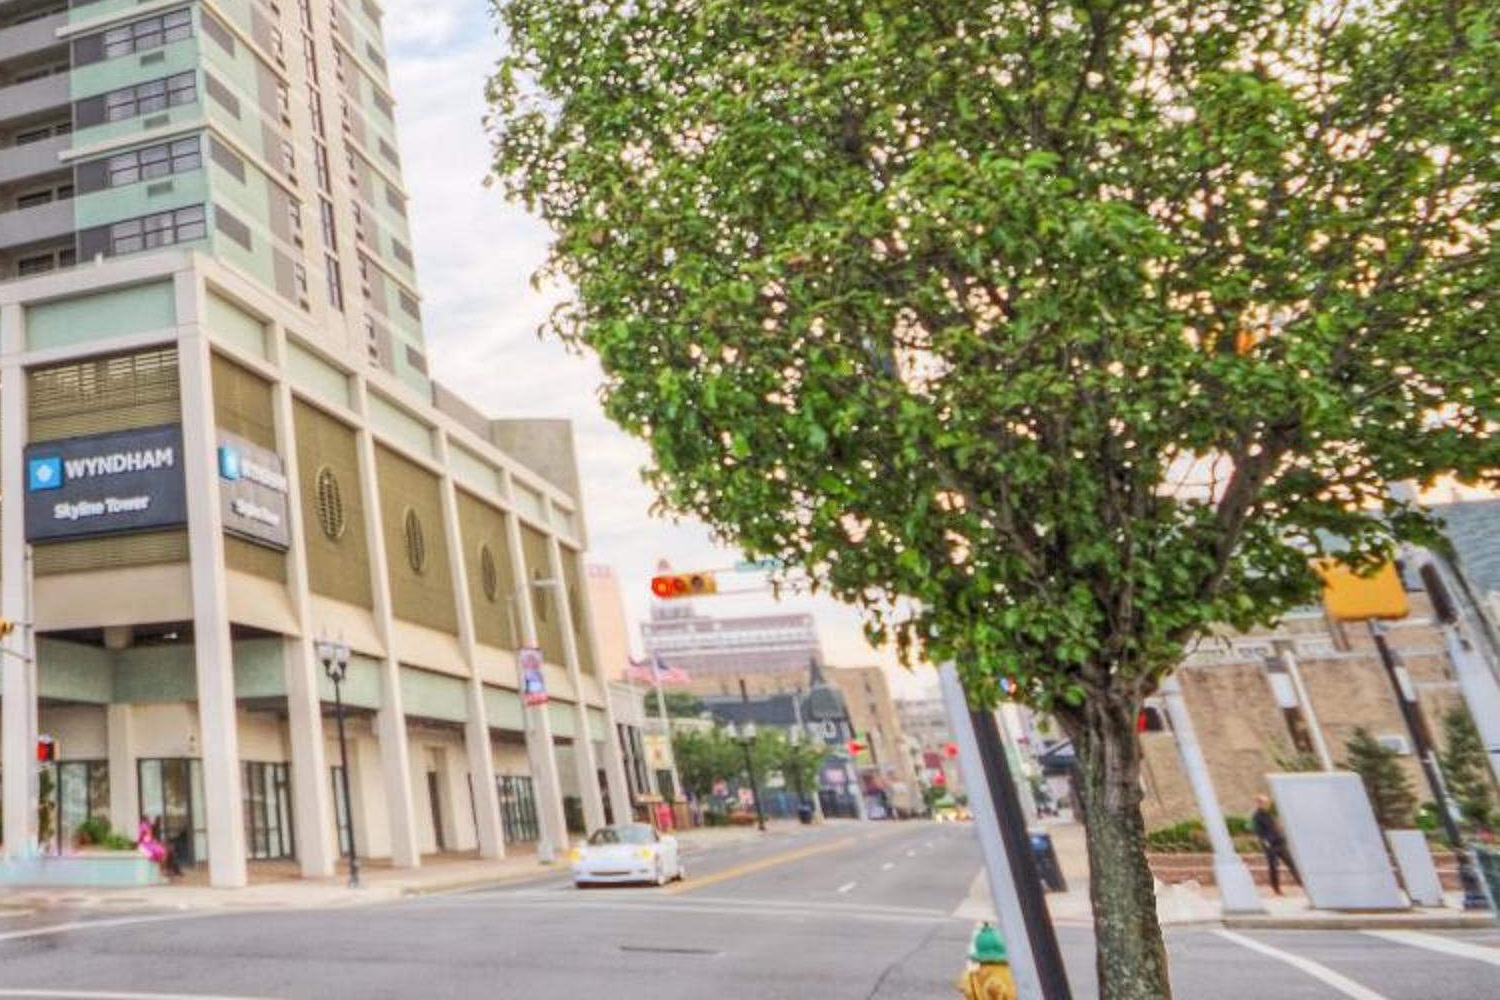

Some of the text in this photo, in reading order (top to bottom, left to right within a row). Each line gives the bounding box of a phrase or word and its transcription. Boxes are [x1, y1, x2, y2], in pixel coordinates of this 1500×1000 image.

[65, 448, 174, 479] WYNDHAM
[54, 497, 150, 520] Skyline Tower
